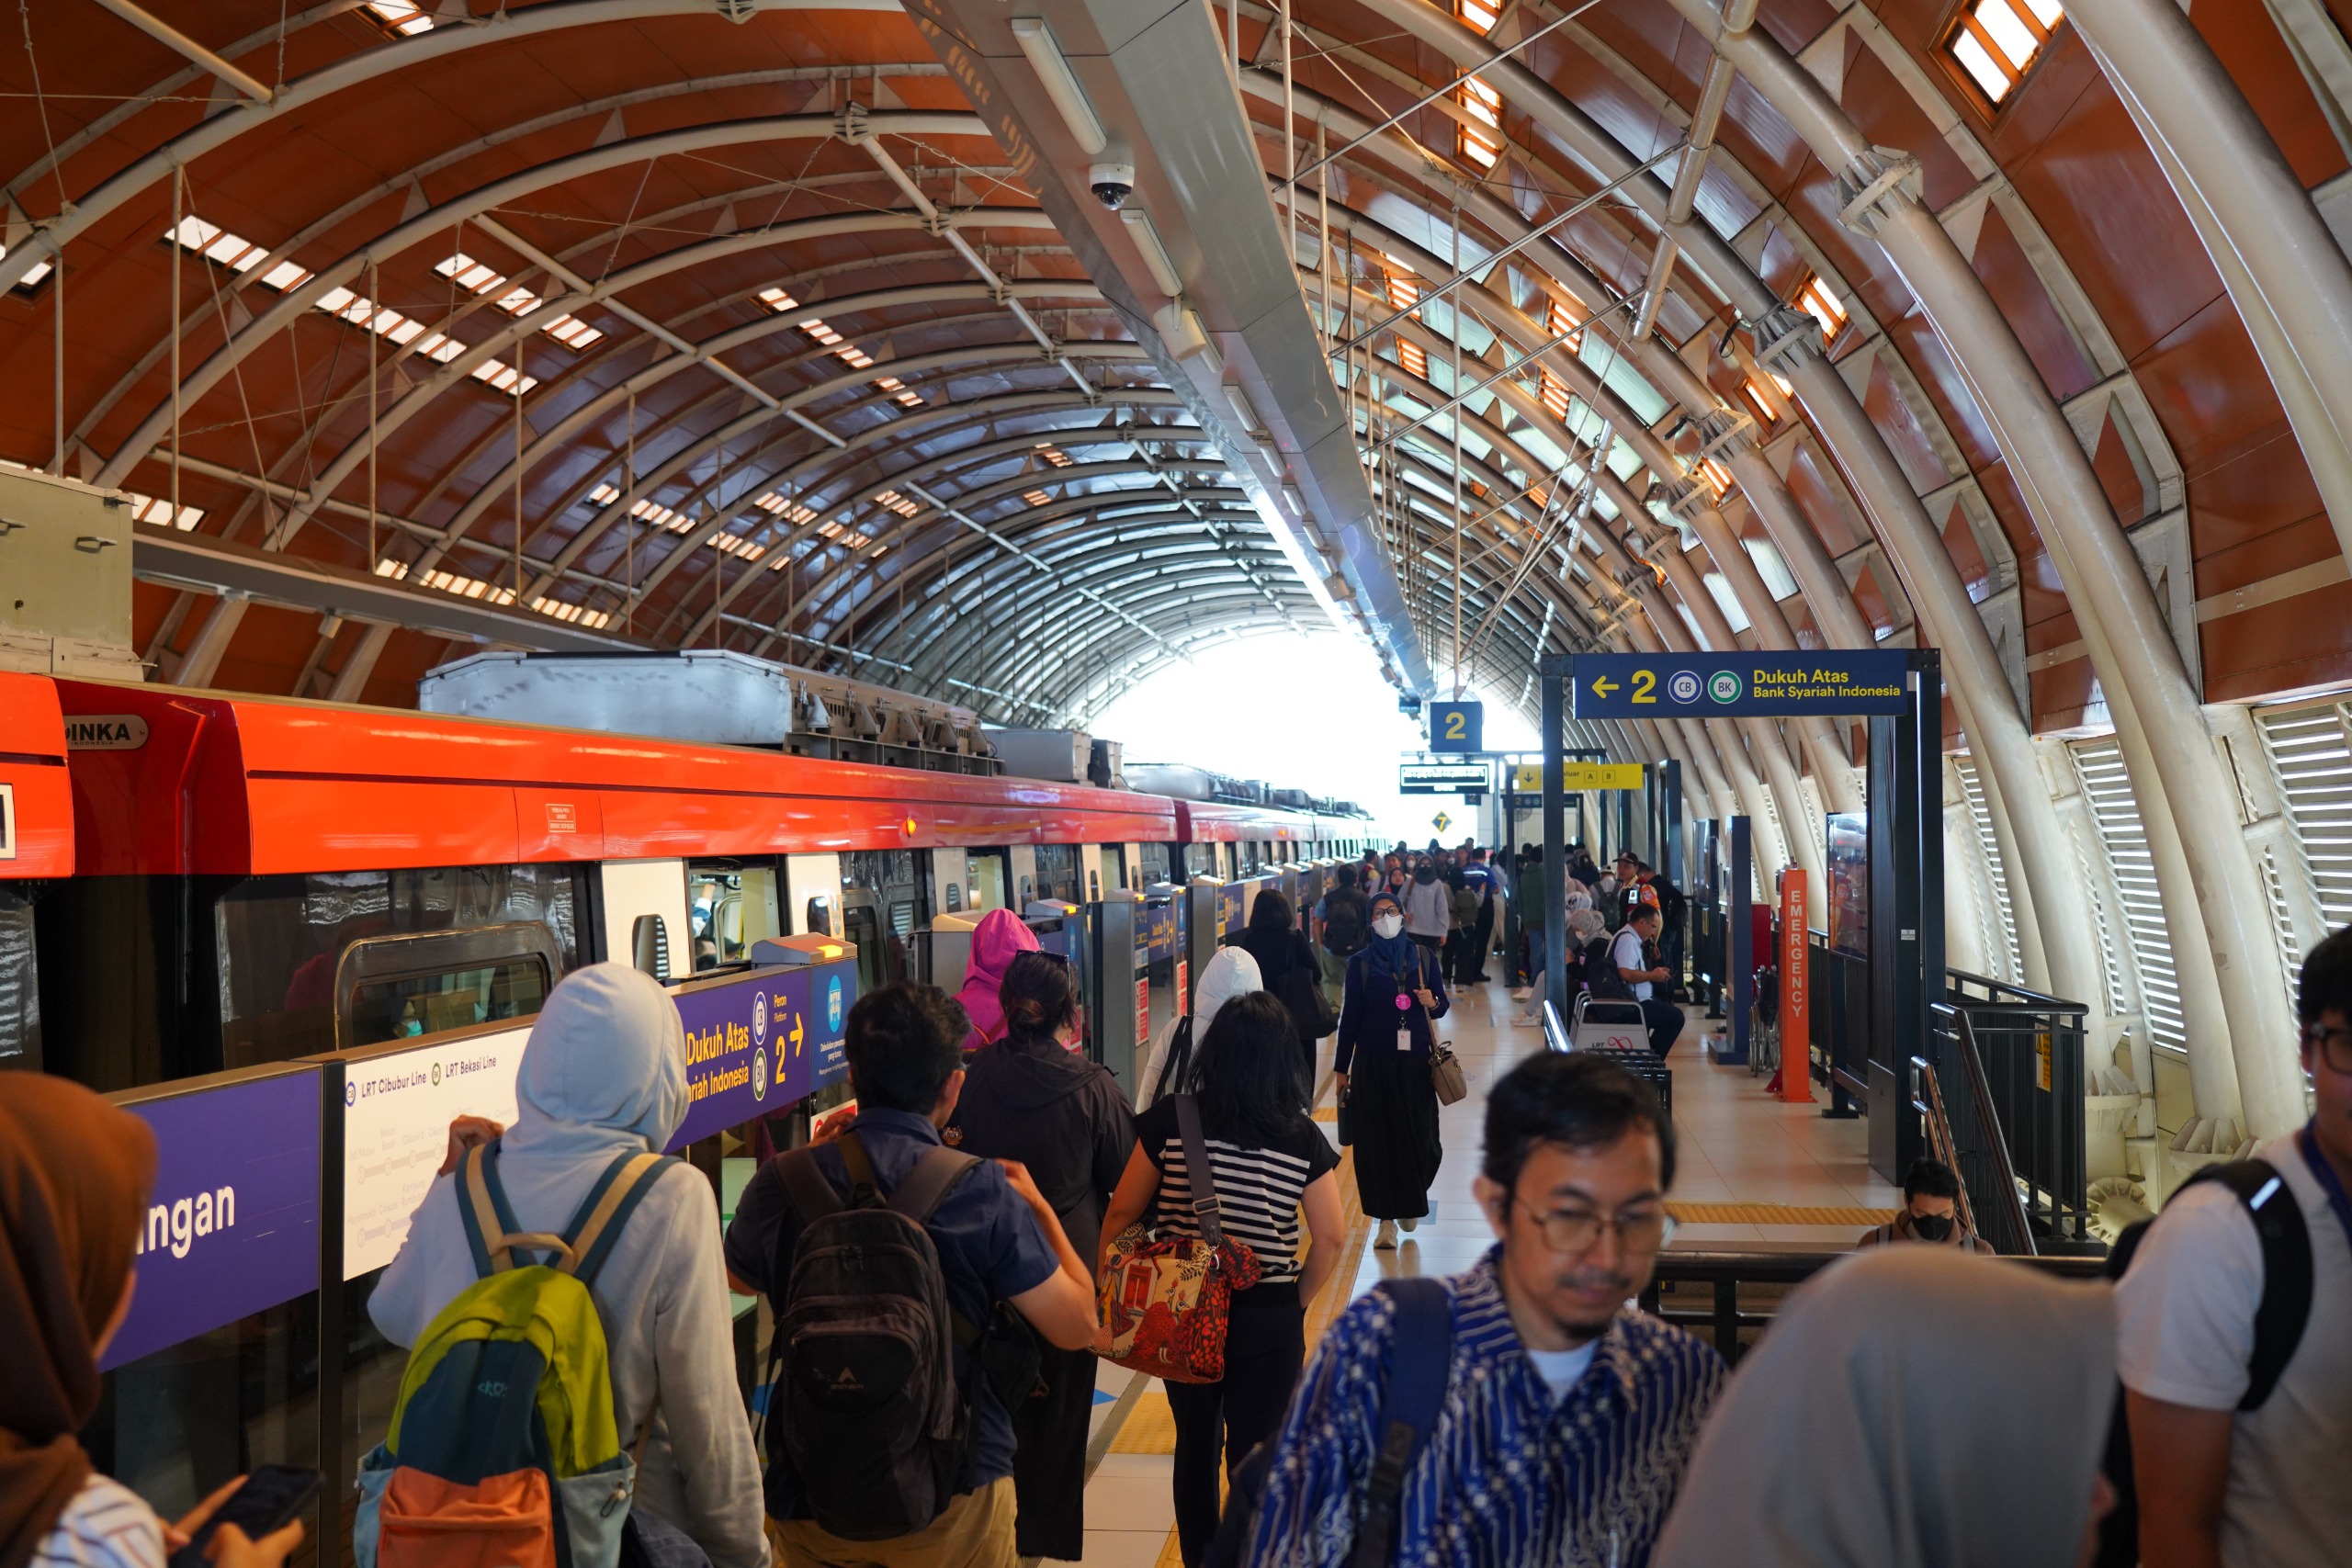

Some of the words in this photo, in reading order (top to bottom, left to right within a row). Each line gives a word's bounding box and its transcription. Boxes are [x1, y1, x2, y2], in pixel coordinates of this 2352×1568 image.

[1632, 670, 1657, 704] 2
[1679, 682, 1692, 693] CB
[1718, 682, 1732, 693] BK
[1753, 669, 1807, 684] Dukuh
[1811, 669, 1849, 683] Atas
[1753, 686, 1785, 698] Bank
[1788, 685, 1836, 700] Syariah
[1838, 684, 1901, 697] Indonesia
[71, 723, 131, 741] INKA
[1445, 712, 1466, 739] 2
[1790, 890, 1803, 1018] EMERGENCY
[774, 994, 787, 1009] Peron
[686, 1024, 723, 1066] Dukuh
[725, 1021, 750, 1055] Atas
[446, 1063, 459, 1077] LRT
[460, 1059, 482, 1075] Bekasi
[482, 1056, 497, 1070] Line
[775, 1035, 786, 1085] 2
[361, 1080, 377, 1098] LRT
[379, 1076, 410, 1094] Cibubur
[411, 1072, 427, 1087] Line
[688, 1072, 708, 1103] ariah
[710, 1059, 749, 1096] Indonesia
